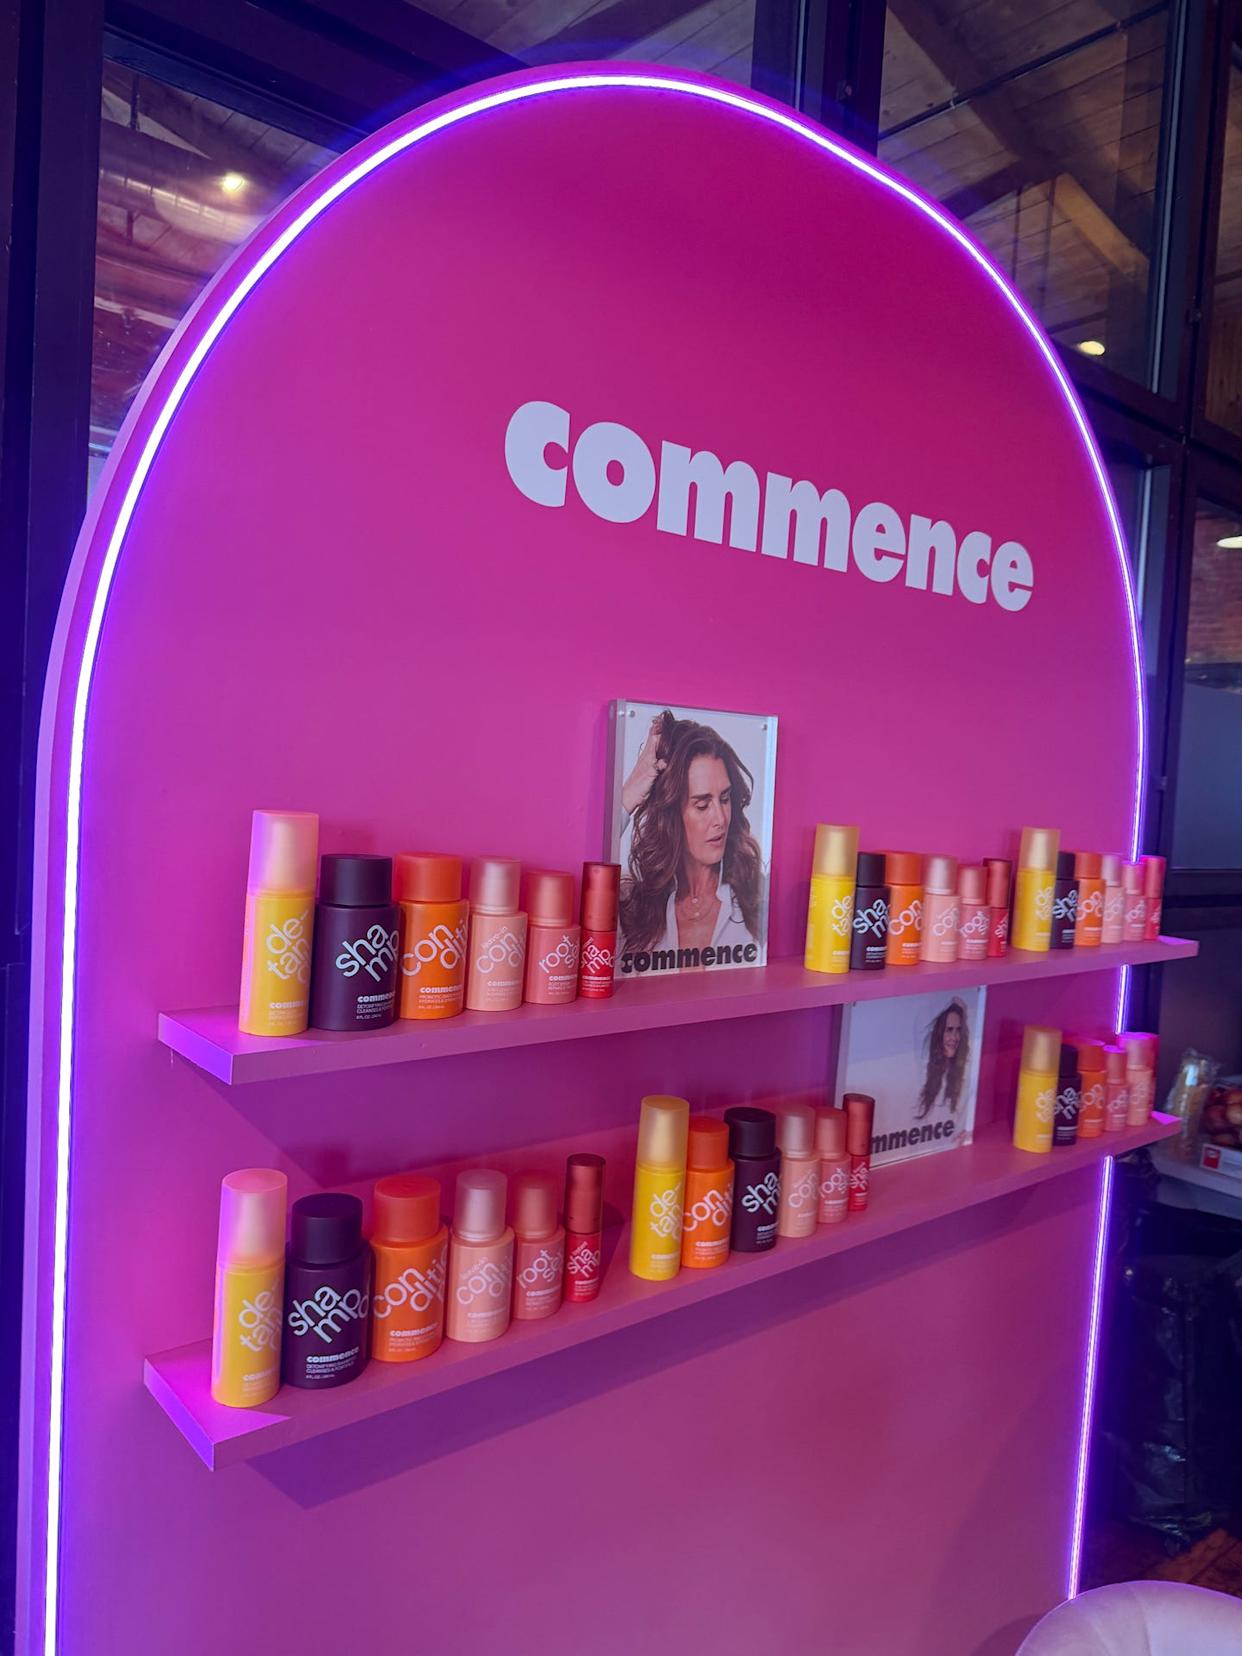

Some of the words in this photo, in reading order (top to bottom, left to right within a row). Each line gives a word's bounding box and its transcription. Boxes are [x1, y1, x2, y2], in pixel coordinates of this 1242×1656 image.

[505, 400, 1034, 612] commence
[853, 899, 887, 934] sha
[336, 924, 389, 977] sha
[401, 924, 455, 977] con
[476, 932, 519, 974] con
[539, 935, 573, 973] root
[621, 943, 757, 974] commence
[741, 1172, 778, 1213] sha
[456, 1262, 499, 1305] con
[516, 1250, 550, 1288] root
[288, 1286, 341, 1336] sha
[373, 1267, 425, 1319] con
